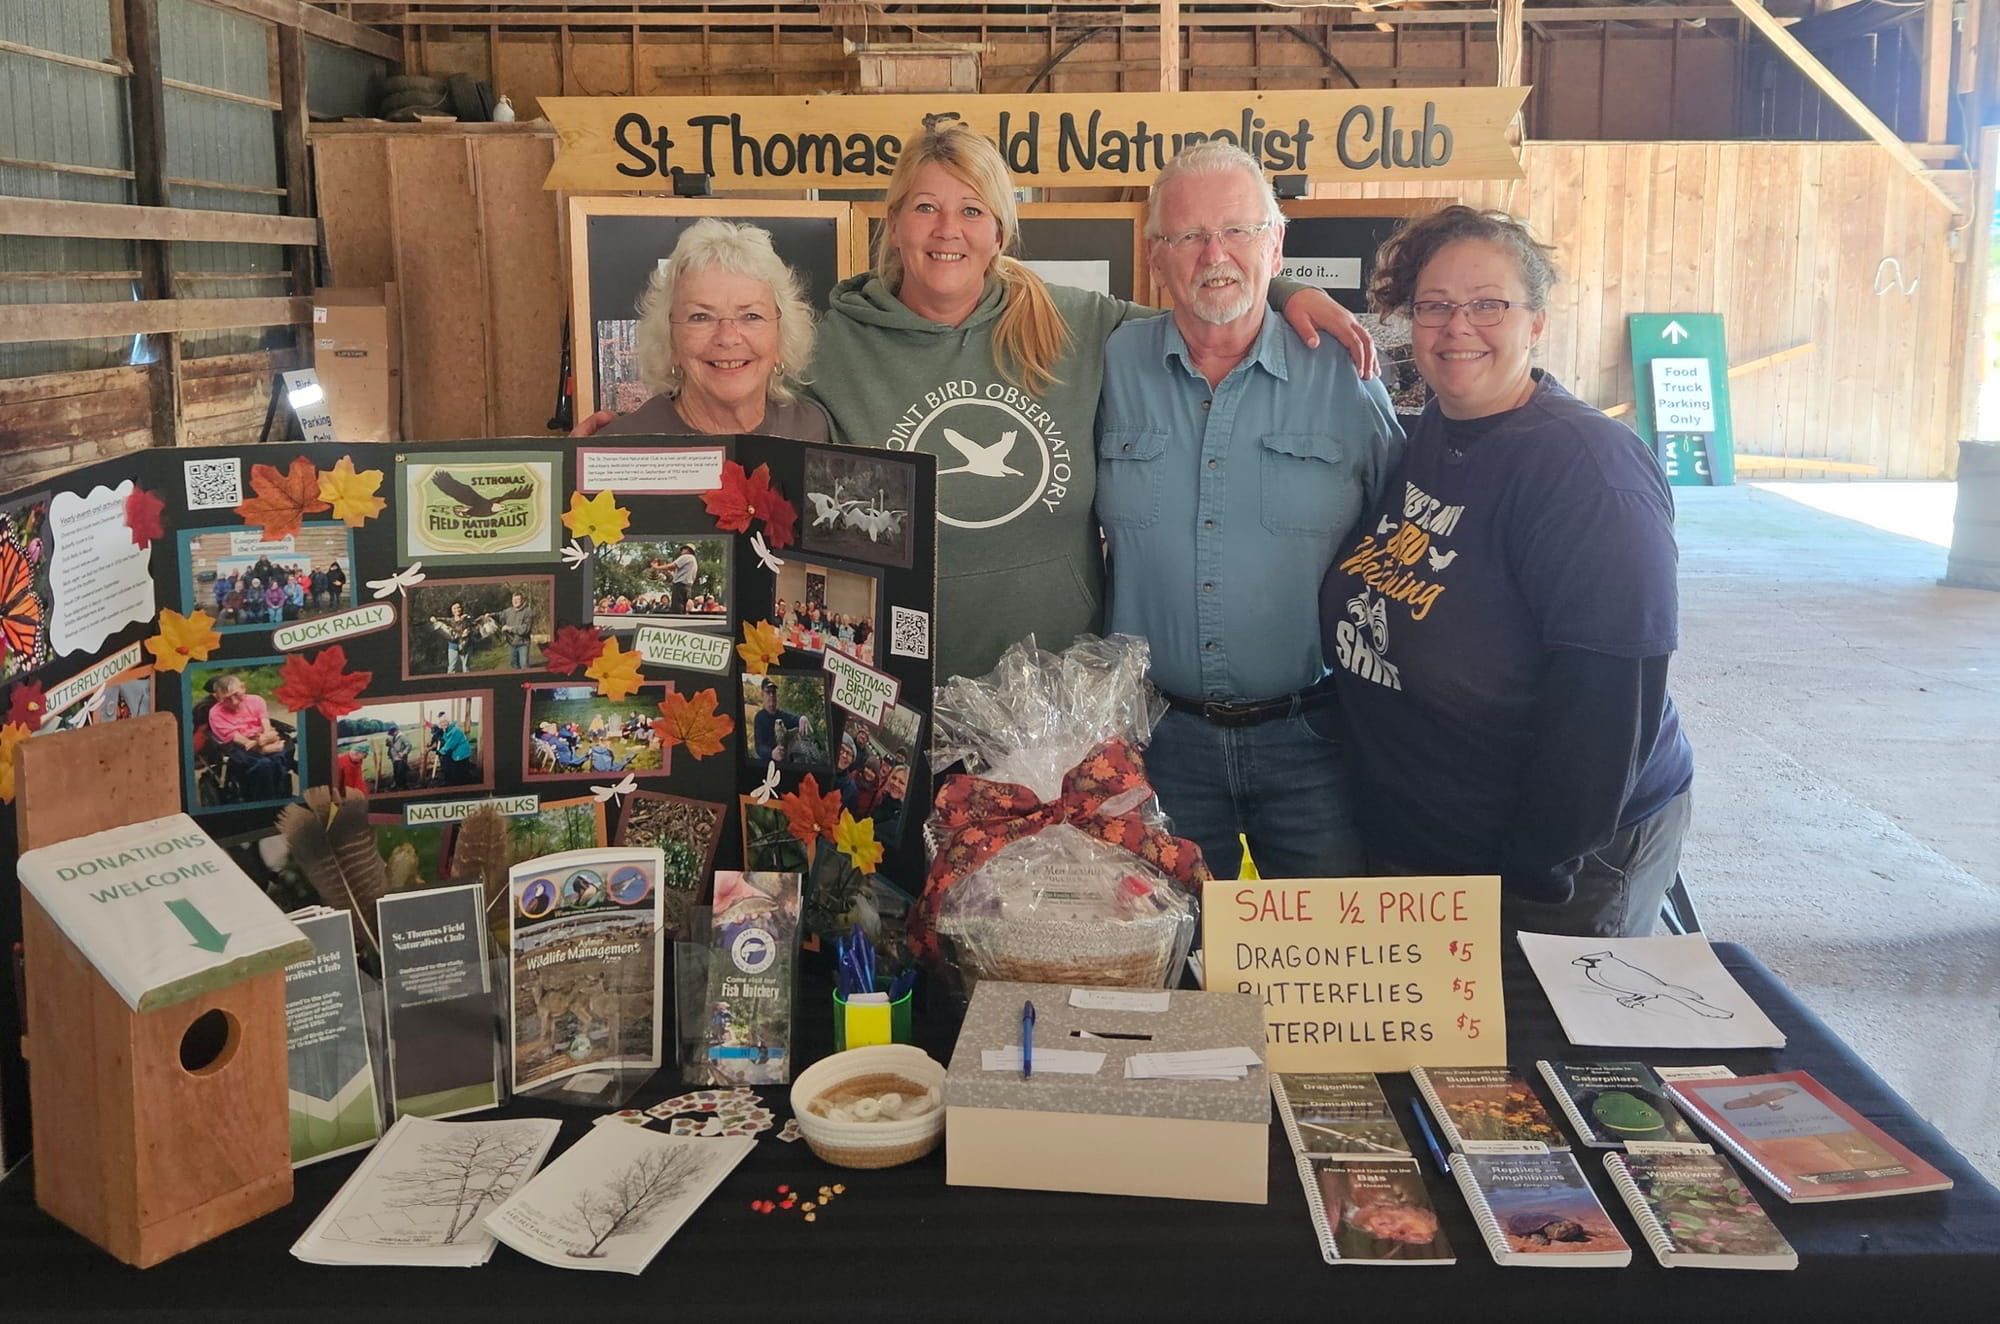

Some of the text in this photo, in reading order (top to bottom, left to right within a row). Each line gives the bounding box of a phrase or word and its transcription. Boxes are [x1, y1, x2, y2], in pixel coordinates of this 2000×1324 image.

[687, 112, 901, 177] Thomas
[1337, 101, 1454, 170] Club
[1296, 265, 1313, 277] do
[1316, 265, 1339, 278] it...
[1665, 367, 1698, 377] Food
[1663, 382, 1703, 392] Truck
[1658, 399, 1710, 411] Parking
[301, 415, 333, 430] Parking
[1670, 414, 1701, 426] Only
[886, 380, 1072, 513] OINT BIRD OBSERVATORY
[428, 511, 529, 531] FIELD NATURALIST
[464, 529, 498, 539] CLUB
[280, 608, 383, 646] DUCK RALLY
[640, 629, 730, 654] HAWK CLIFF
[649, 645, 722, 667] WEEKEND
[48, 647, 139, 711] UTTERFLY COUNT
[828, 657, 893, 698] CHRISTMAS
[846, 678, 873, 702] BIRD
[836, 688, 879, 718] COUNT
[56, 833, 207, 882] DONATIONS
[89, 860, 220, 904] WELCOME
[1235, 889, 1313, 922] SALE
[1380, 890, 1468, 923] PRICE
[406, 928, 442, 940] Thomas
[443, 922, 465, 934] Field
[444, 932, 465, 943] Club
[526, 942, 641, 971] Wildlife Management
[1236, 940, 1474, 970] DRAGONFLIES $5
[722, 982, 739, 998] Fish
[1452, 977, 1476, 1001] $5
[1265, 1013, 1481, 1044] TERPILLERS $5
[1303, 1083, 1366, 1092] Dragonflies
[1571, 1074, 1639, 1084] Caterpillars
[1356, 1173, 1388, 1183] Bats
[1491, 1166, 1543, 1174] Reptiles
[1491, 1174, 1566, 1183] Amphibians
[1646, 1170, 1721, 1180] Wildflowers
